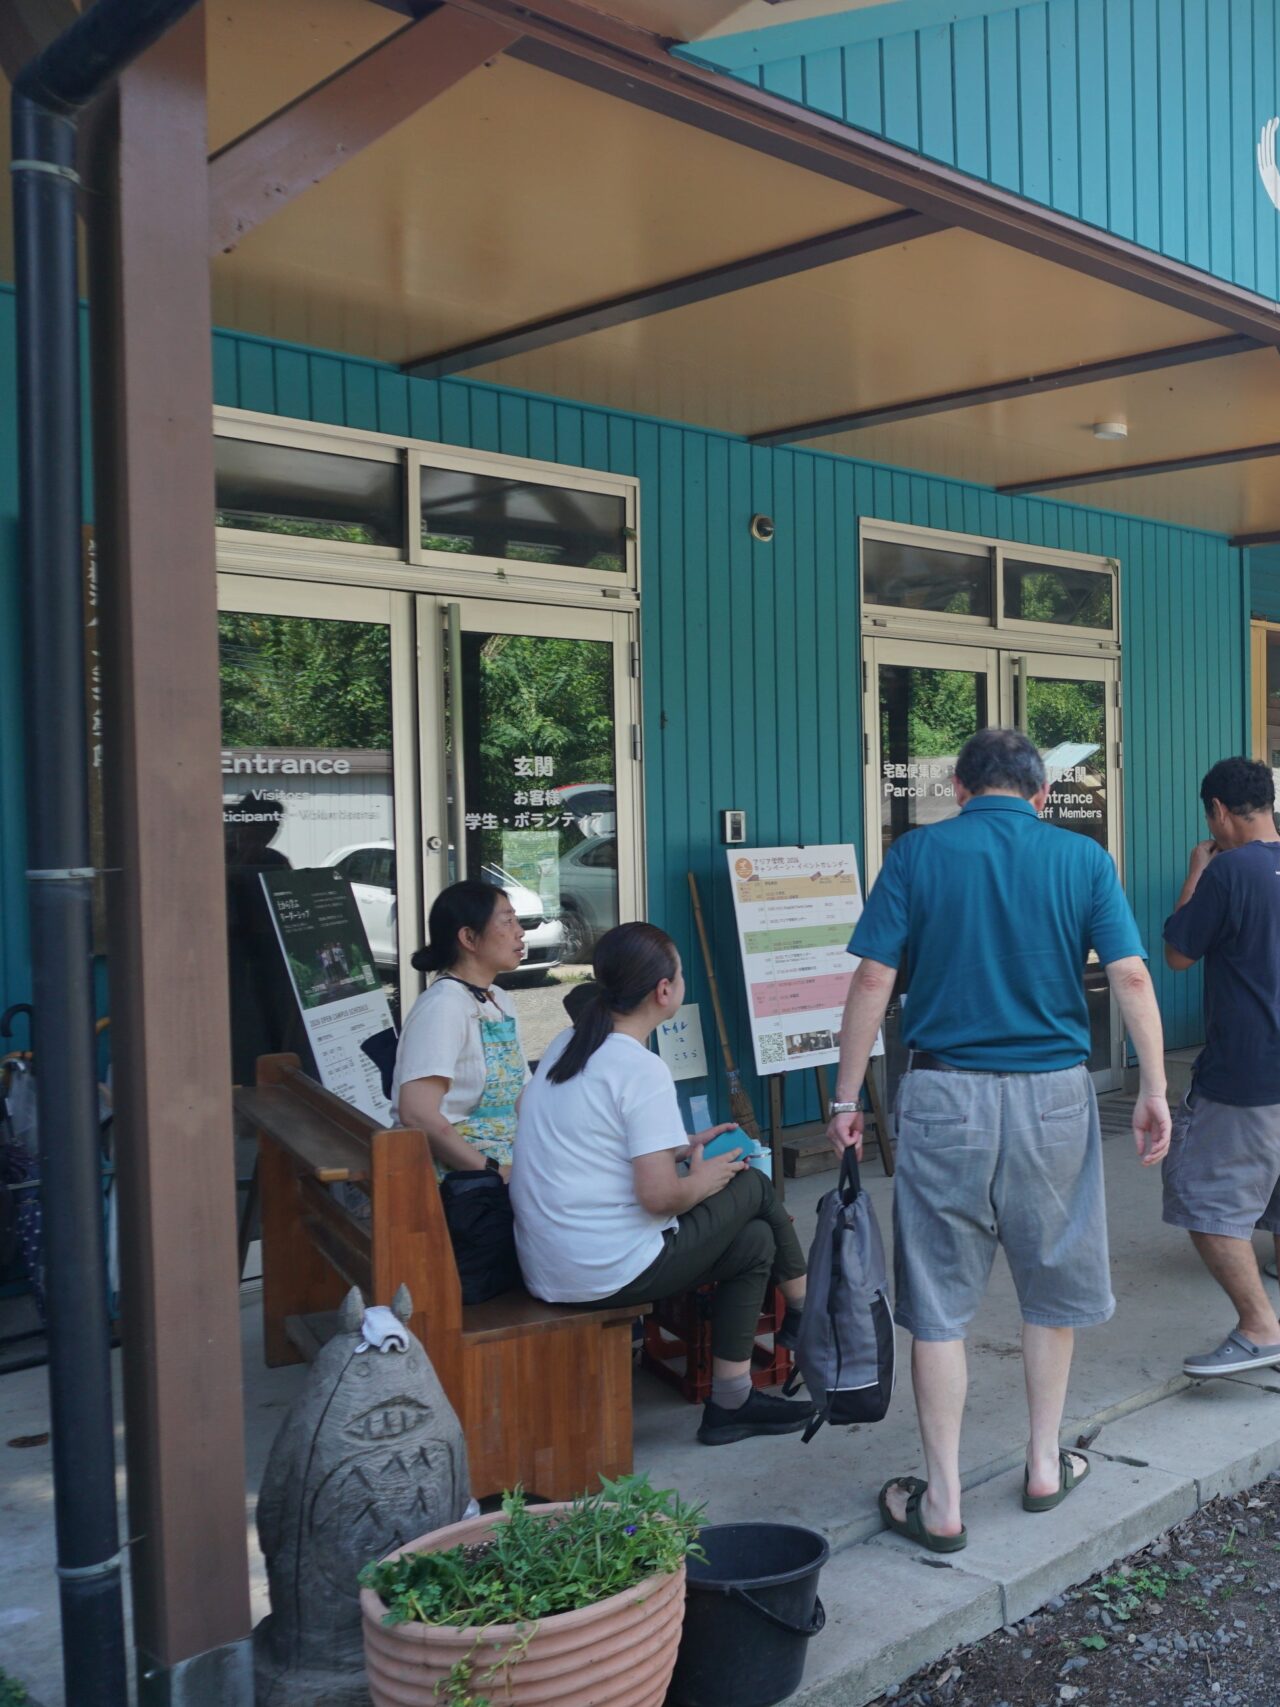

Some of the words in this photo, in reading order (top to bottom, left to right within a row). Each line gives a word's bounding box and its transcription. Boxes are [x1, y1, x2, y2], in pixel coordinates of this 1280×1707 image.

[513, 756, 554, 777] 玄関
[513, 789, 561, 806] お客様
[884, 783, 927, 798] Parcel
[934, 783, 958, 798] Del
[1045, 790, 1093, 804] ntrance
[465, 811, 604, 830] 学生・ボランティア
[1037, 806, 1053, 819] aff
[1058, 806, 1102, 819] Members
